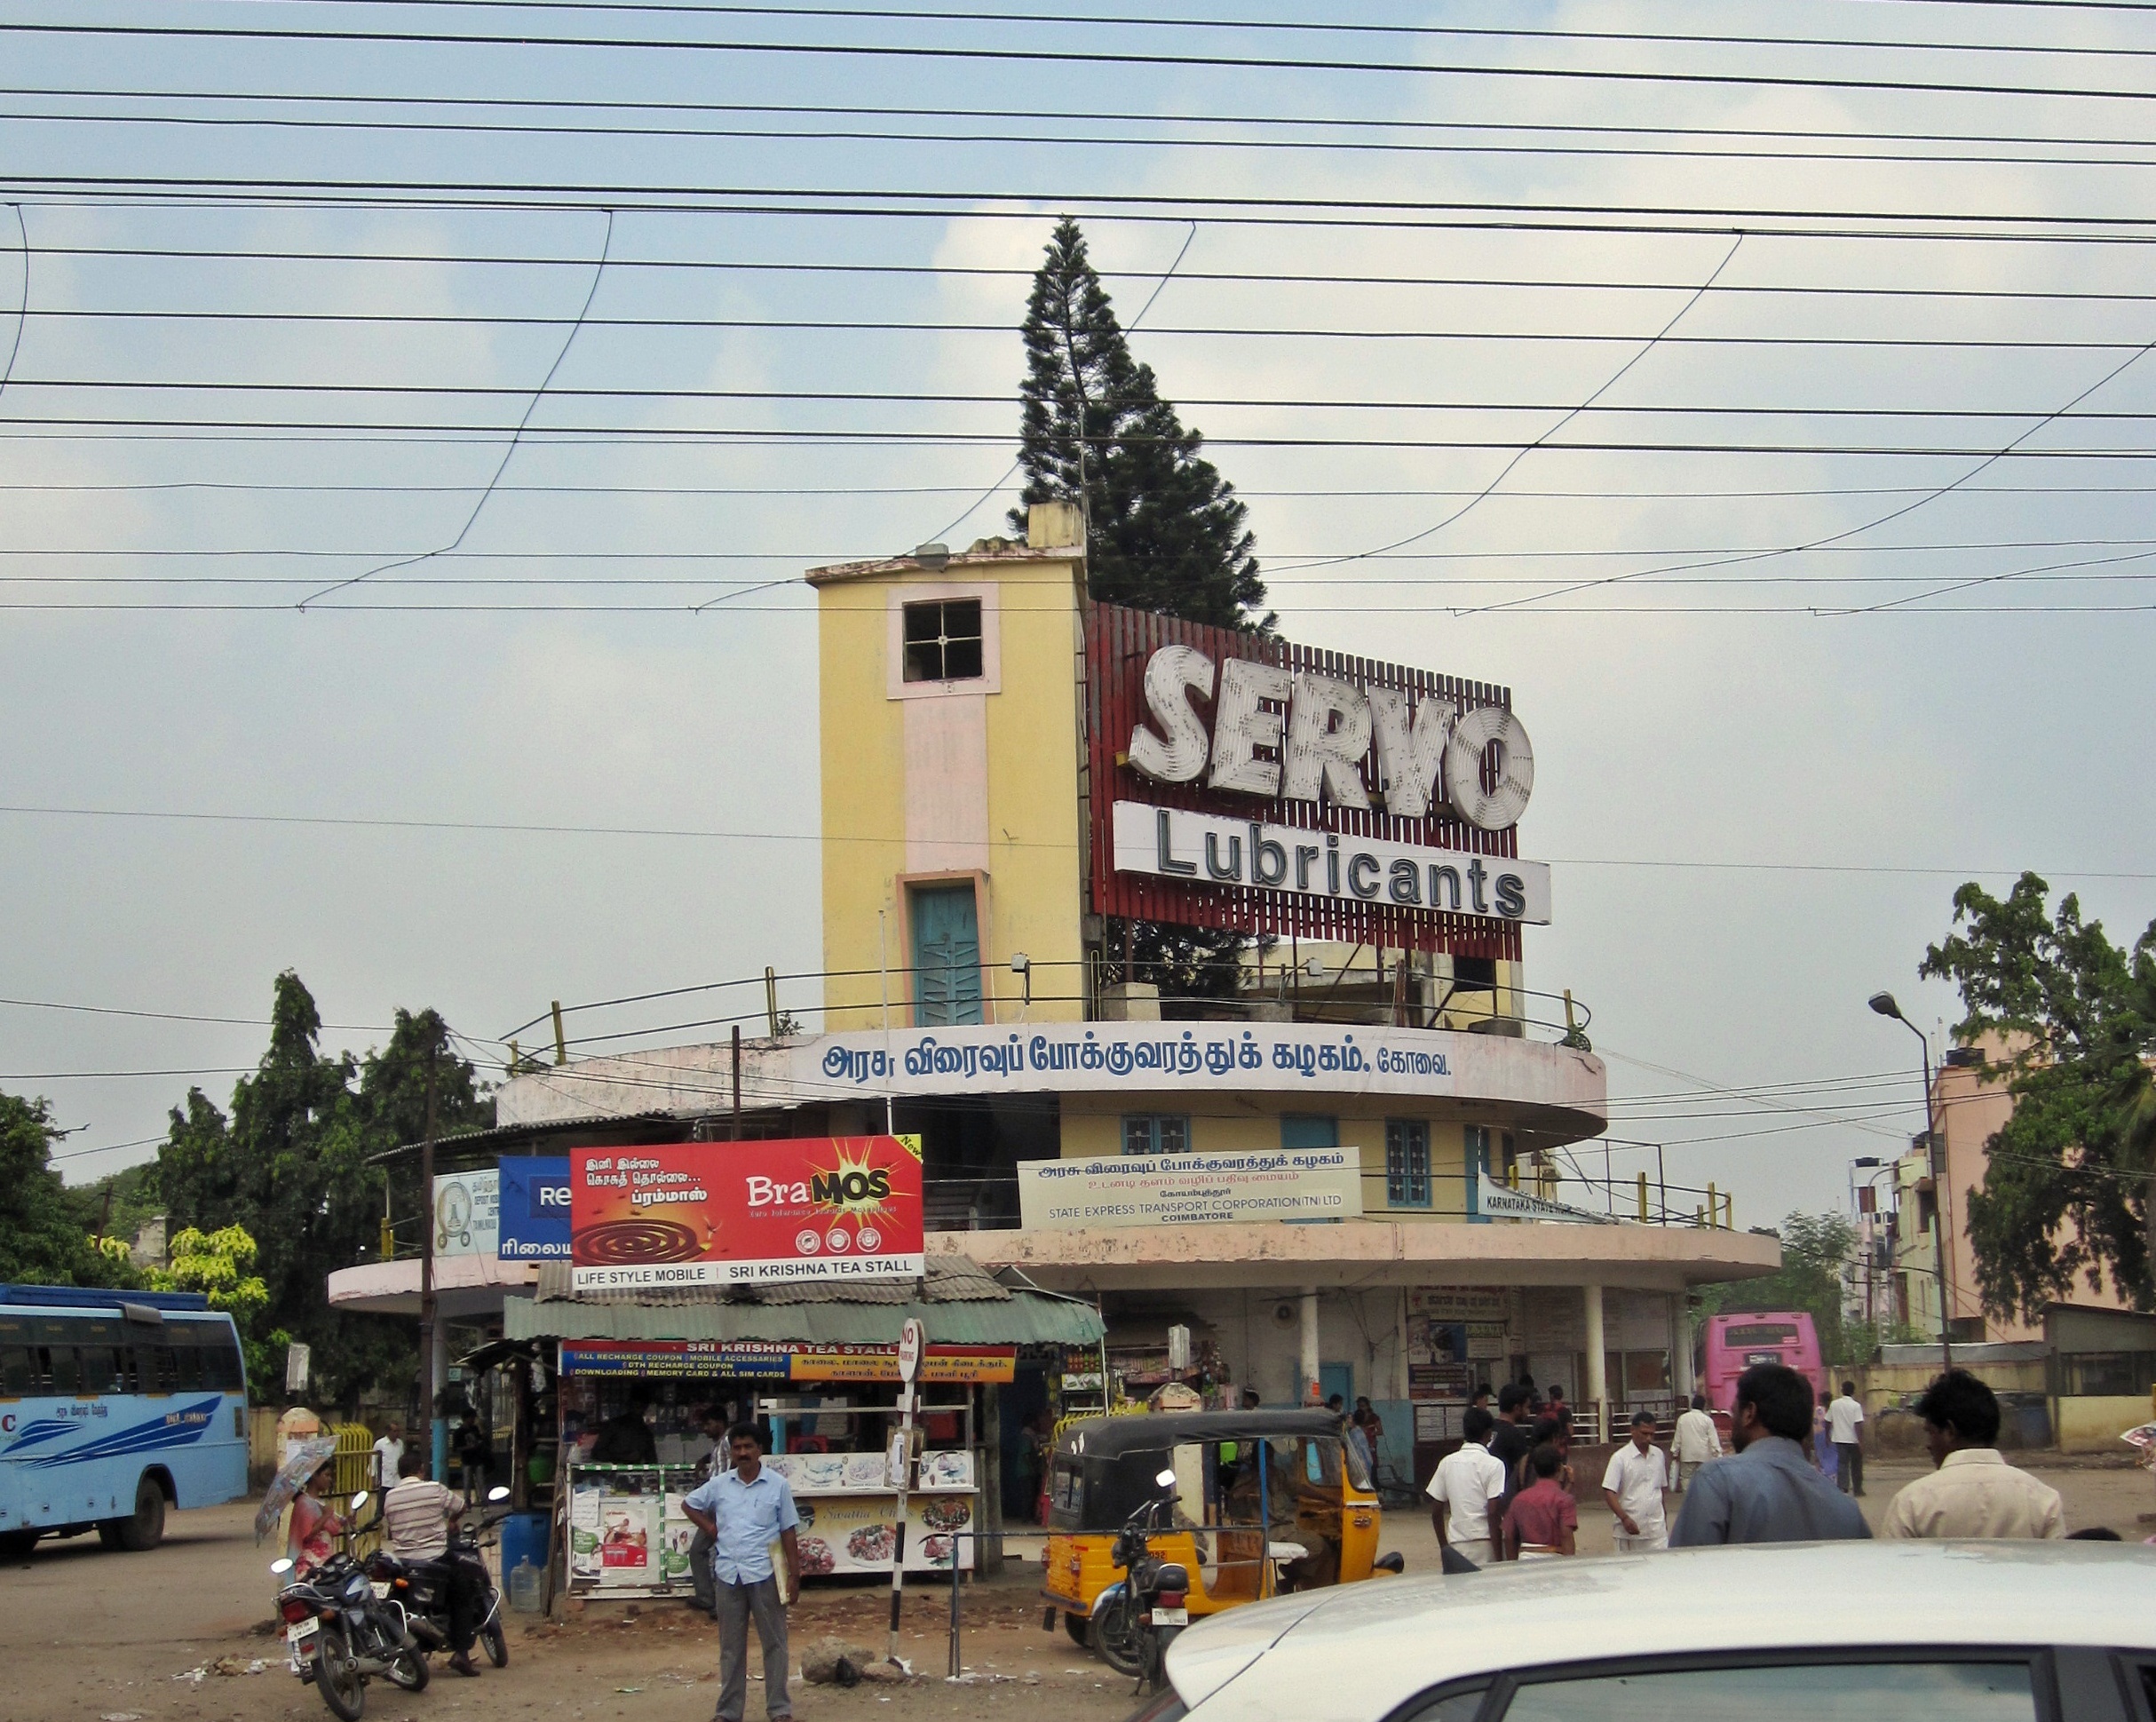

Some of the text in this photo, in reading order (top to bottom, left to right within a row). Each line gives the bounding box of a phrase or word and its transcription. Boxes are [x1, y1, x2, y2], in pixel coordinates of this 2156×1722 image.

[1128, 645, 1534, 831] SERVO
[1157, 810, 1526, 917] Lubricants
[822, 1045, 895, 1083] அரசு
[904, 1033, 1024, 1078] விரைவுப்
[1028, 1030, 1262, 1075] போக்குவரத்துக்
[900, 1136, 921, 1156] New
[585, 1157, 660, 1170] இனி இல்லை
[1038, 1152, 1344, 1178] அரசு விரைவுப் போக்குவரத்துக் கழகம்
[587, 1171, 628, 1187] கொசுத்
[746, 1169, 891, 1207] BraMOS
[631, 1186, 707, 1207] ப்ரம்மாஸ்
[1049, 1207, 1080, 1218] STATE
[1085, 1204, 1136, 1217] EXPRESS
[1139, 1201, 1208, 1214] TRANSPORT
[1323, 1194, 1342, 1205] LTD
[1486, 1195, 1531, 1211] KARNATAKA
[1161, 1212, 1233, 1223] COIMBATORE
[578, 1260, 912, 1285] LIFE STYLE MOBILE SRI KRISHNA TEA STALL
[901, 1327, 914, 1345] NO
[686, 1343, 896, 1355] SRI KRISHNA TEA STALL
